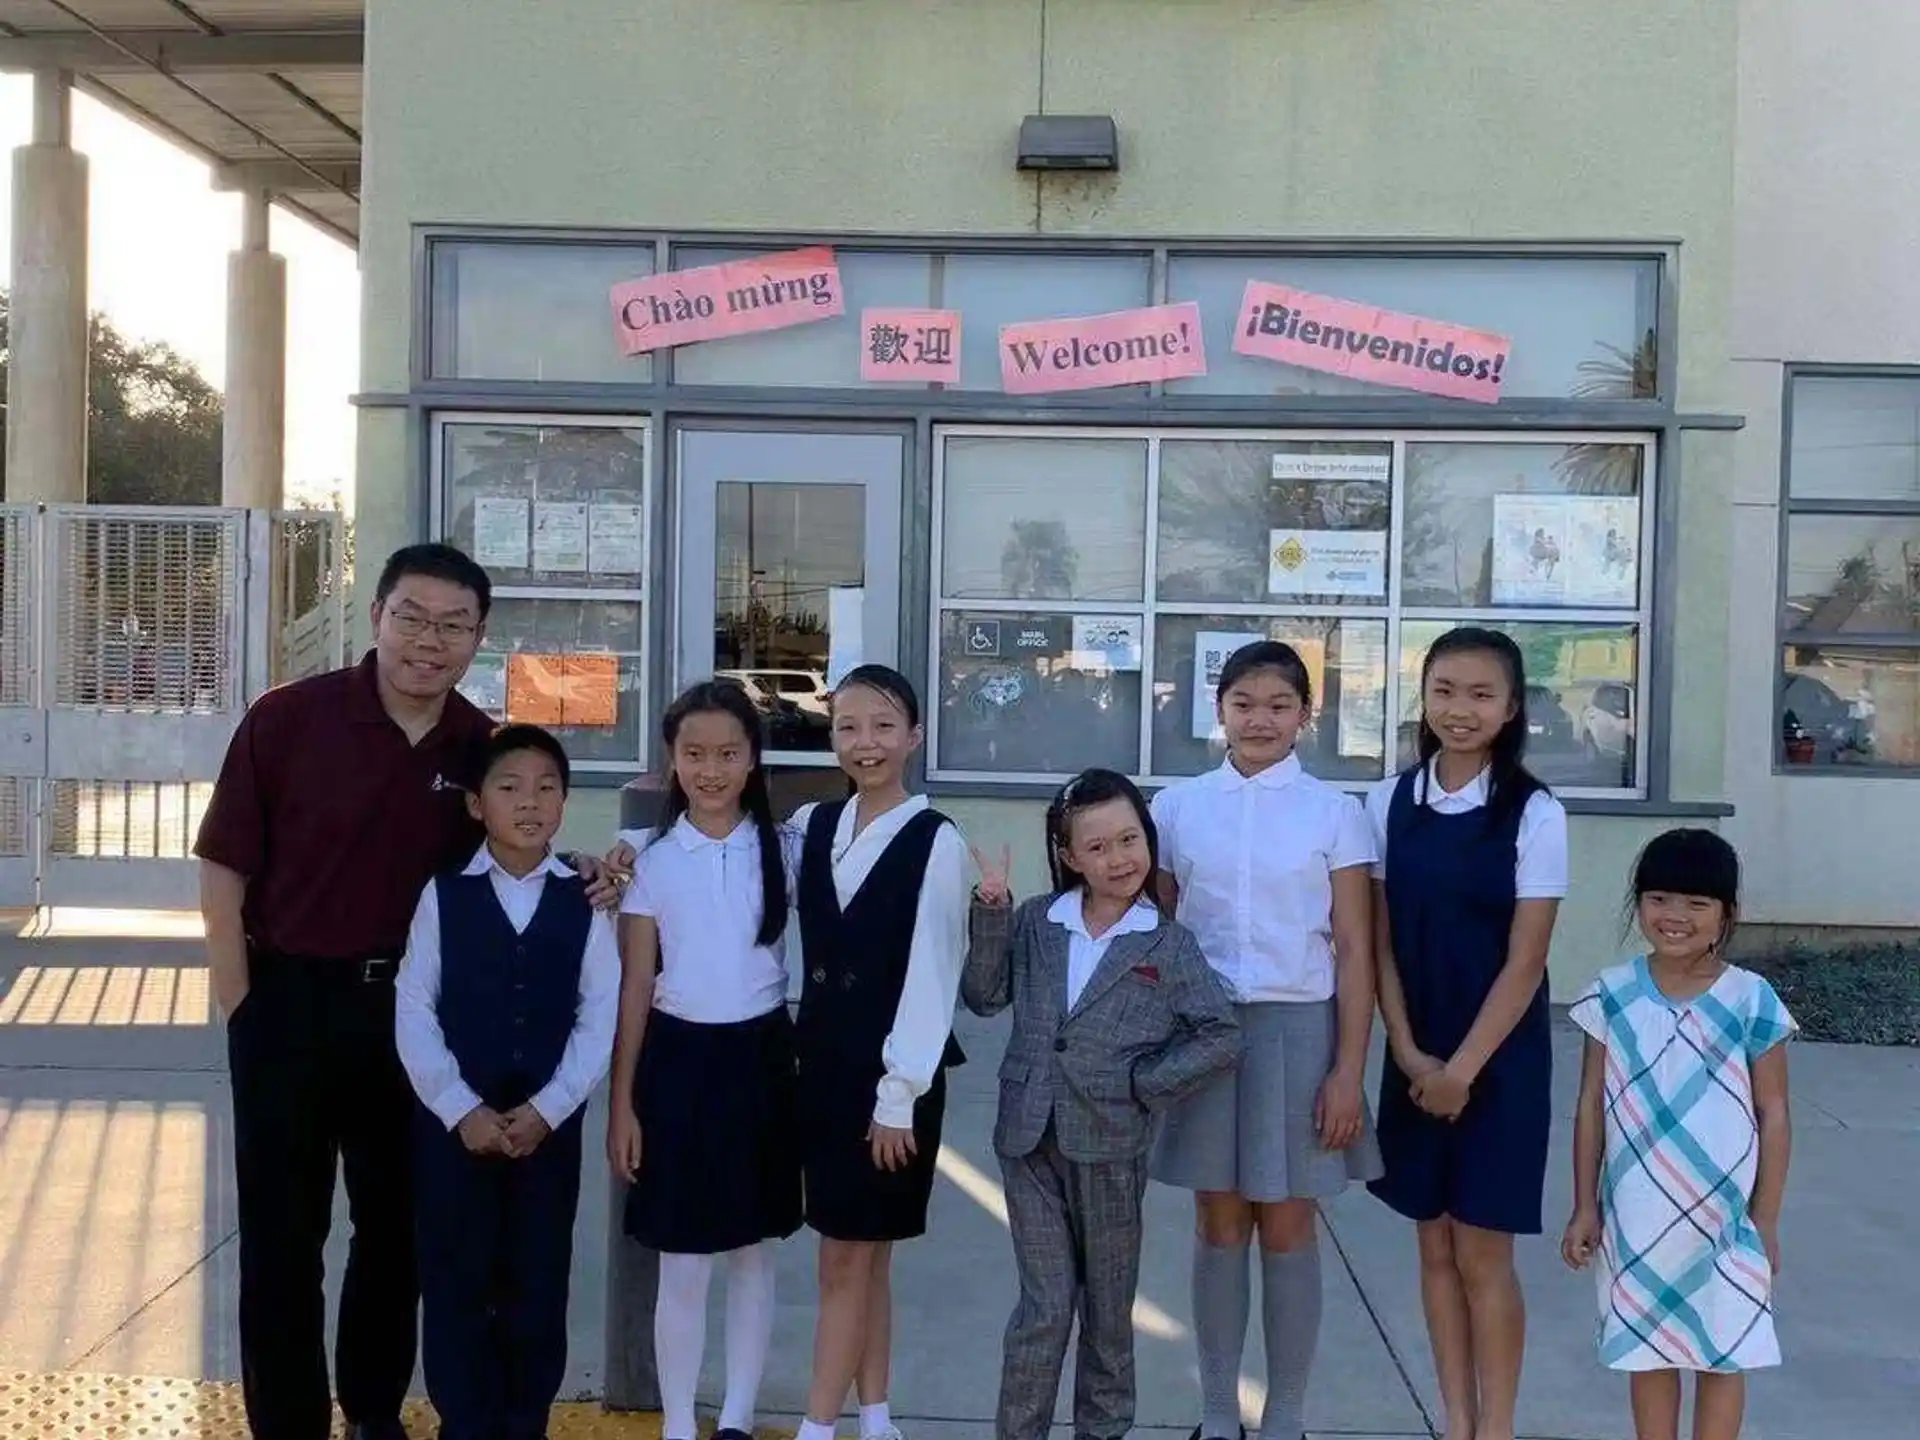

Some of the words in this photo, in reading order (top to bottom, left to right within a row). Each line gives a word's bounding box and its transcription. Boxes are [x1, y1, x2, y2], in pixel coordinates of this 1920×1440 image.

[621, 289, 715, 331] Chào
[726, 272, 833, 312] mừng
[869, 323, 952, 364] 歡迎
[1008, 322, 1191, 374] Welcome!
[1246, 301, 1506, 384] ¡Bienvenidos!
[1016, 638, 1049, 647] OFFICE
